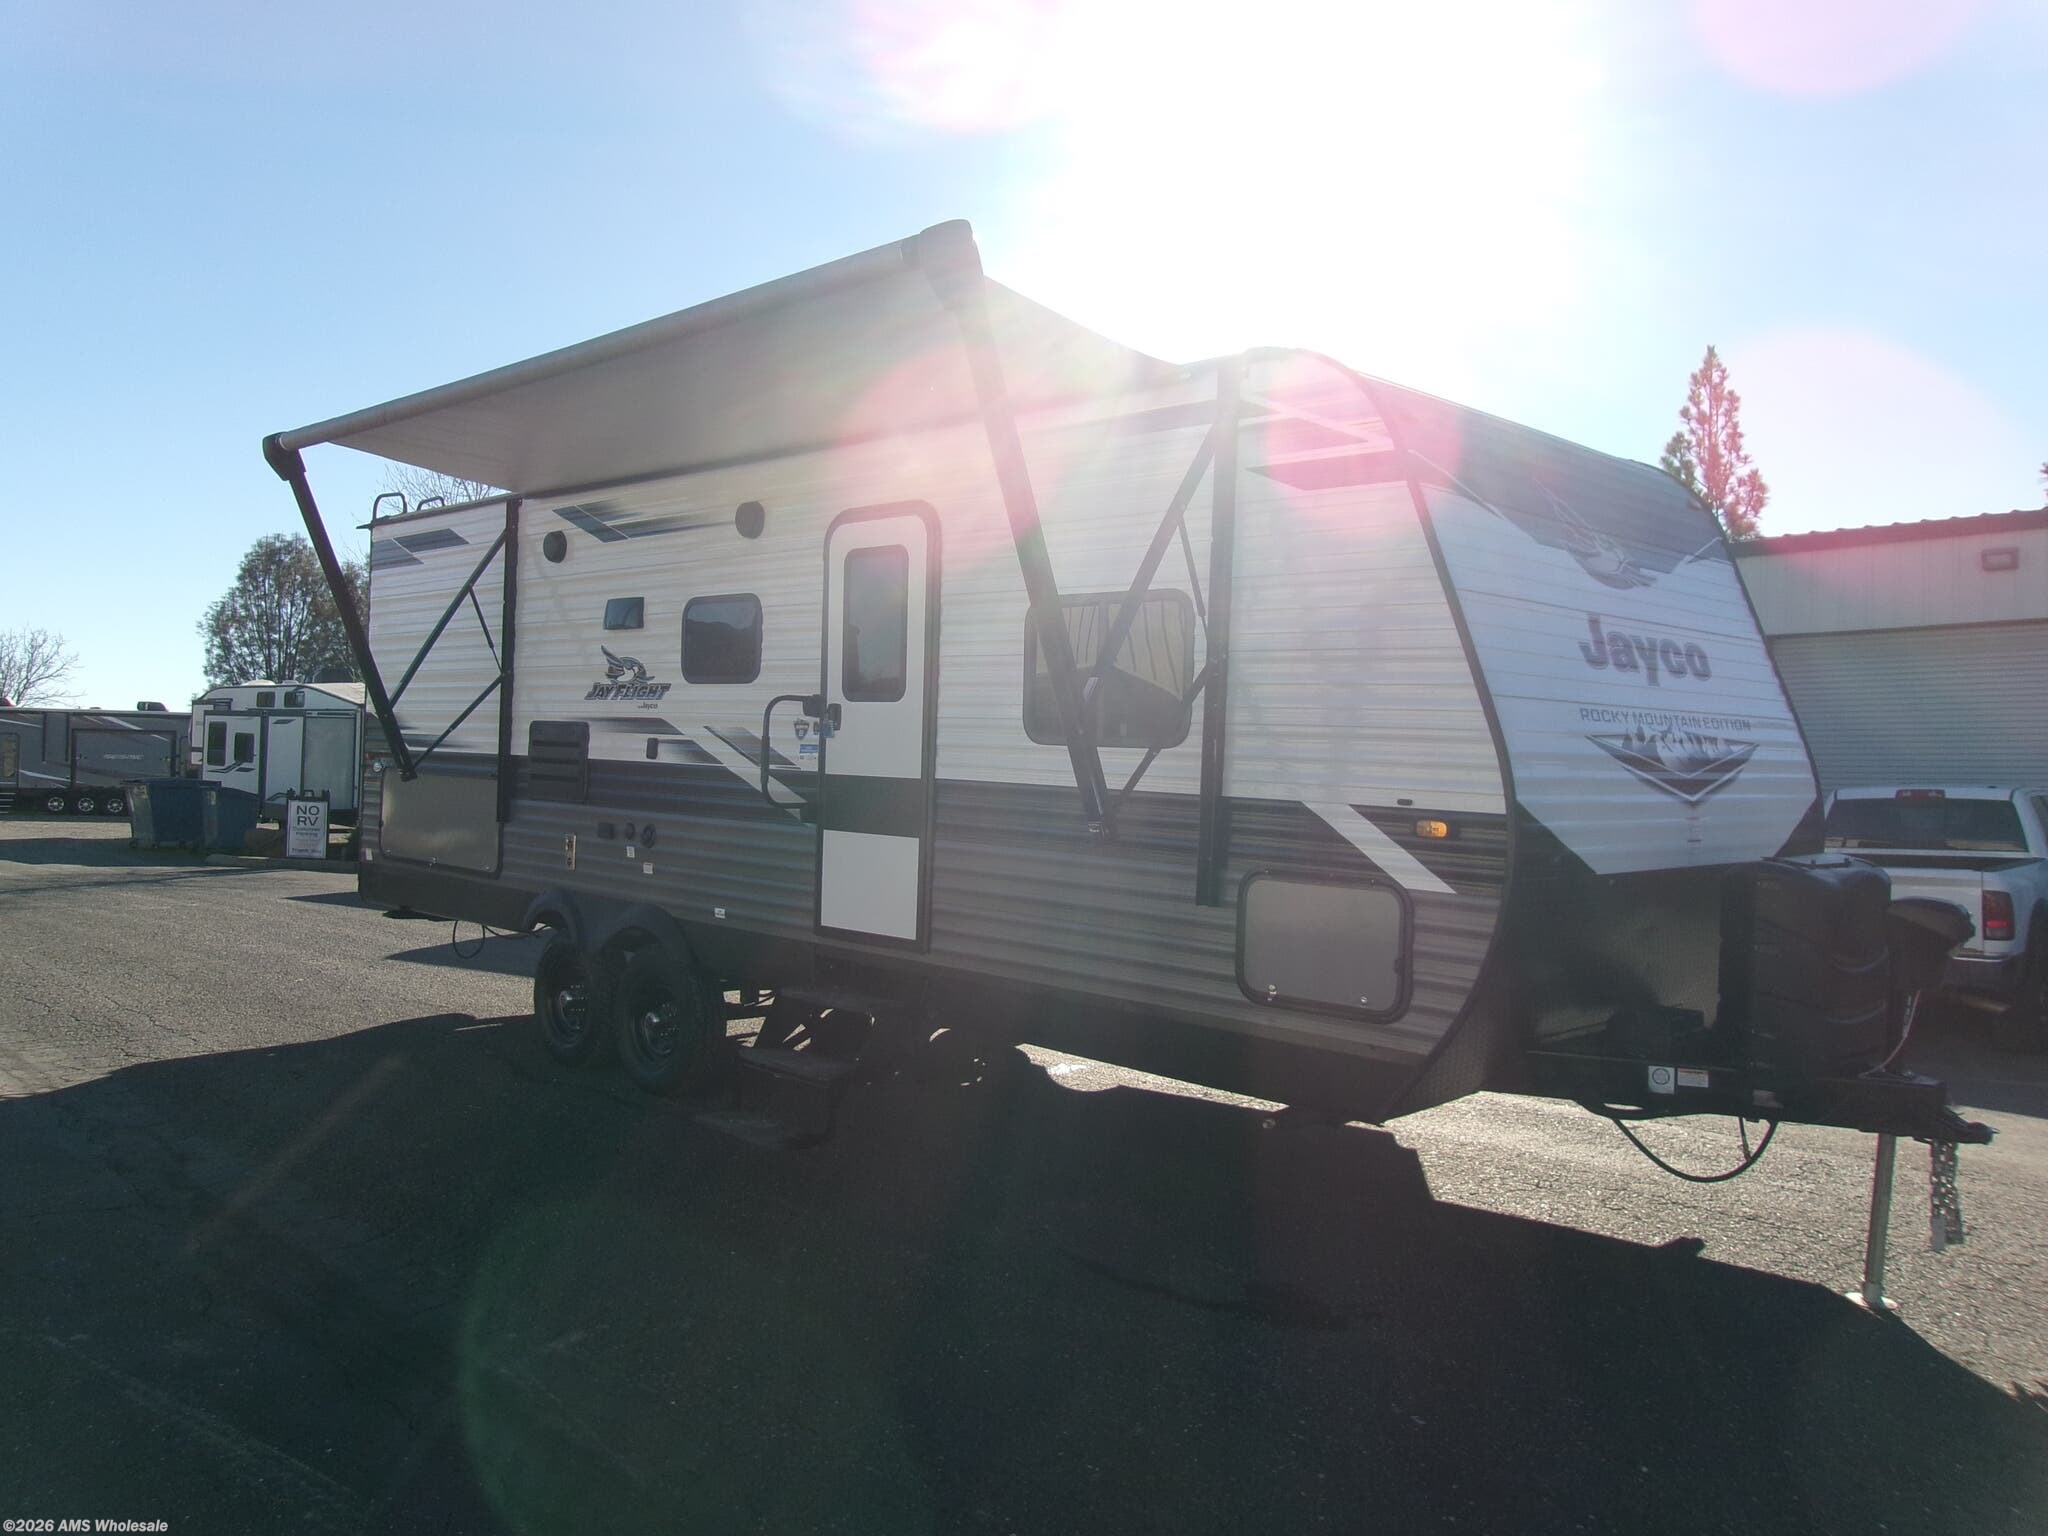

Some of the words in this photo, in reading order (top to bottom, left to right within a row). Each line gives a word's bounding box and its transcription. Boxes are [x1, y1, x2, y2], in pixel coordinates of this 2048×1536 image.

[1577, 612, 1712, 687] Jayco
[584, 682, 617, 701] JAY
[613, 682, 672, 701] FLIGHT
[1579, 707, 1631, 724] ROCKY
[1631, 711, 1702, 729] MOUNTAIN
[1702, 718, 1751, 731] EDITION
[296, 805, 320, 815] NO
[297, 816, 319, 826] RV
